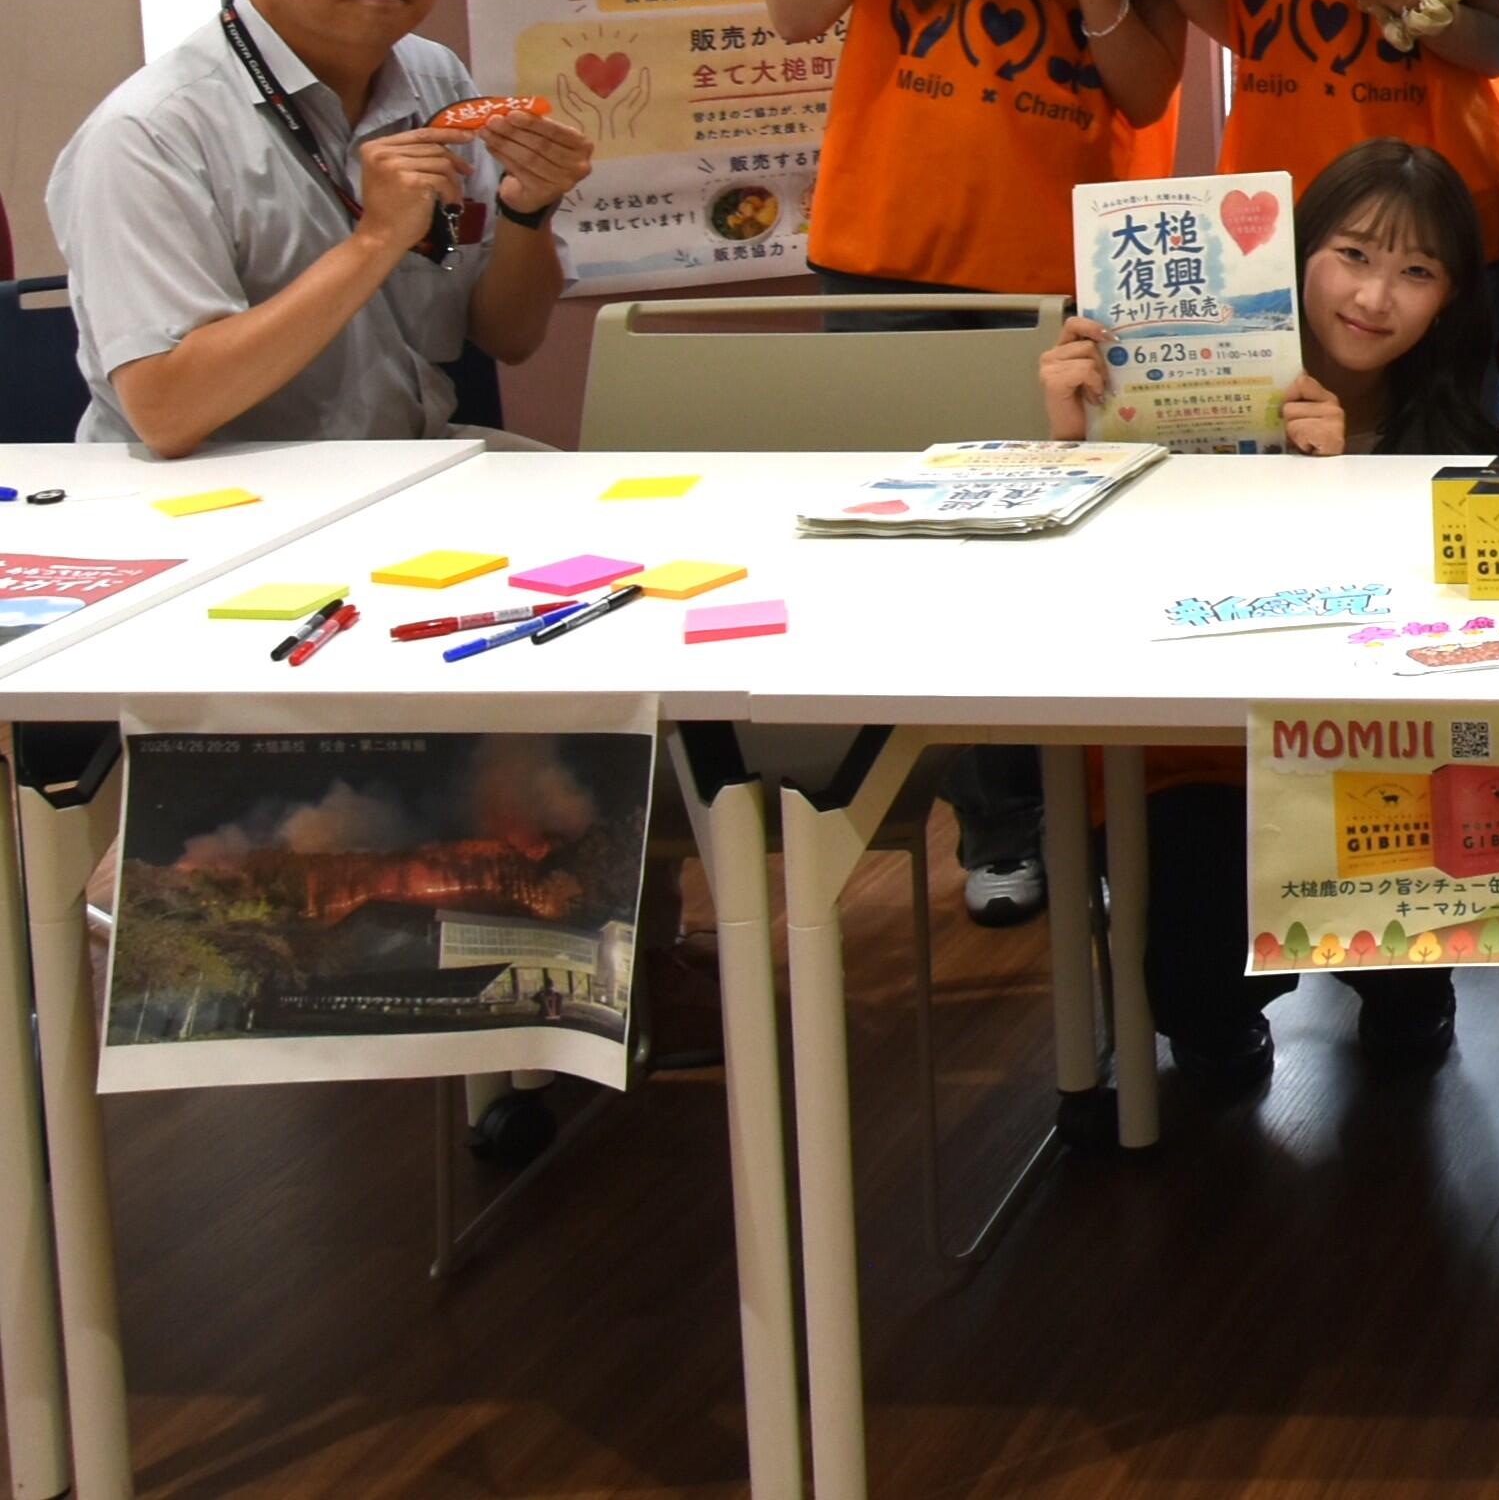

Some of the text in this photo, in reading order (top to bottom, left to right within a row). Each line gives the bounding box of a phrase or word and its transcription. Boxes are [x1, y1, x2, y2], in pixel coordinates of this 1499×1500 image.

[896, 69, 1095, 130] Meijo Charity
[1352, 84, 1427, 105] Charity
[594, 192, 674, 211] 心を込めて
[1111, 210, 1205, 260] 大槌
[1117, 257, 1206, 301] 復興
[1110, 297, 1219, 323] チャリティ販売
[1273, 720, 1434, 759] MOMIJI
[1347, 833, 1431, 852] GIBIER
